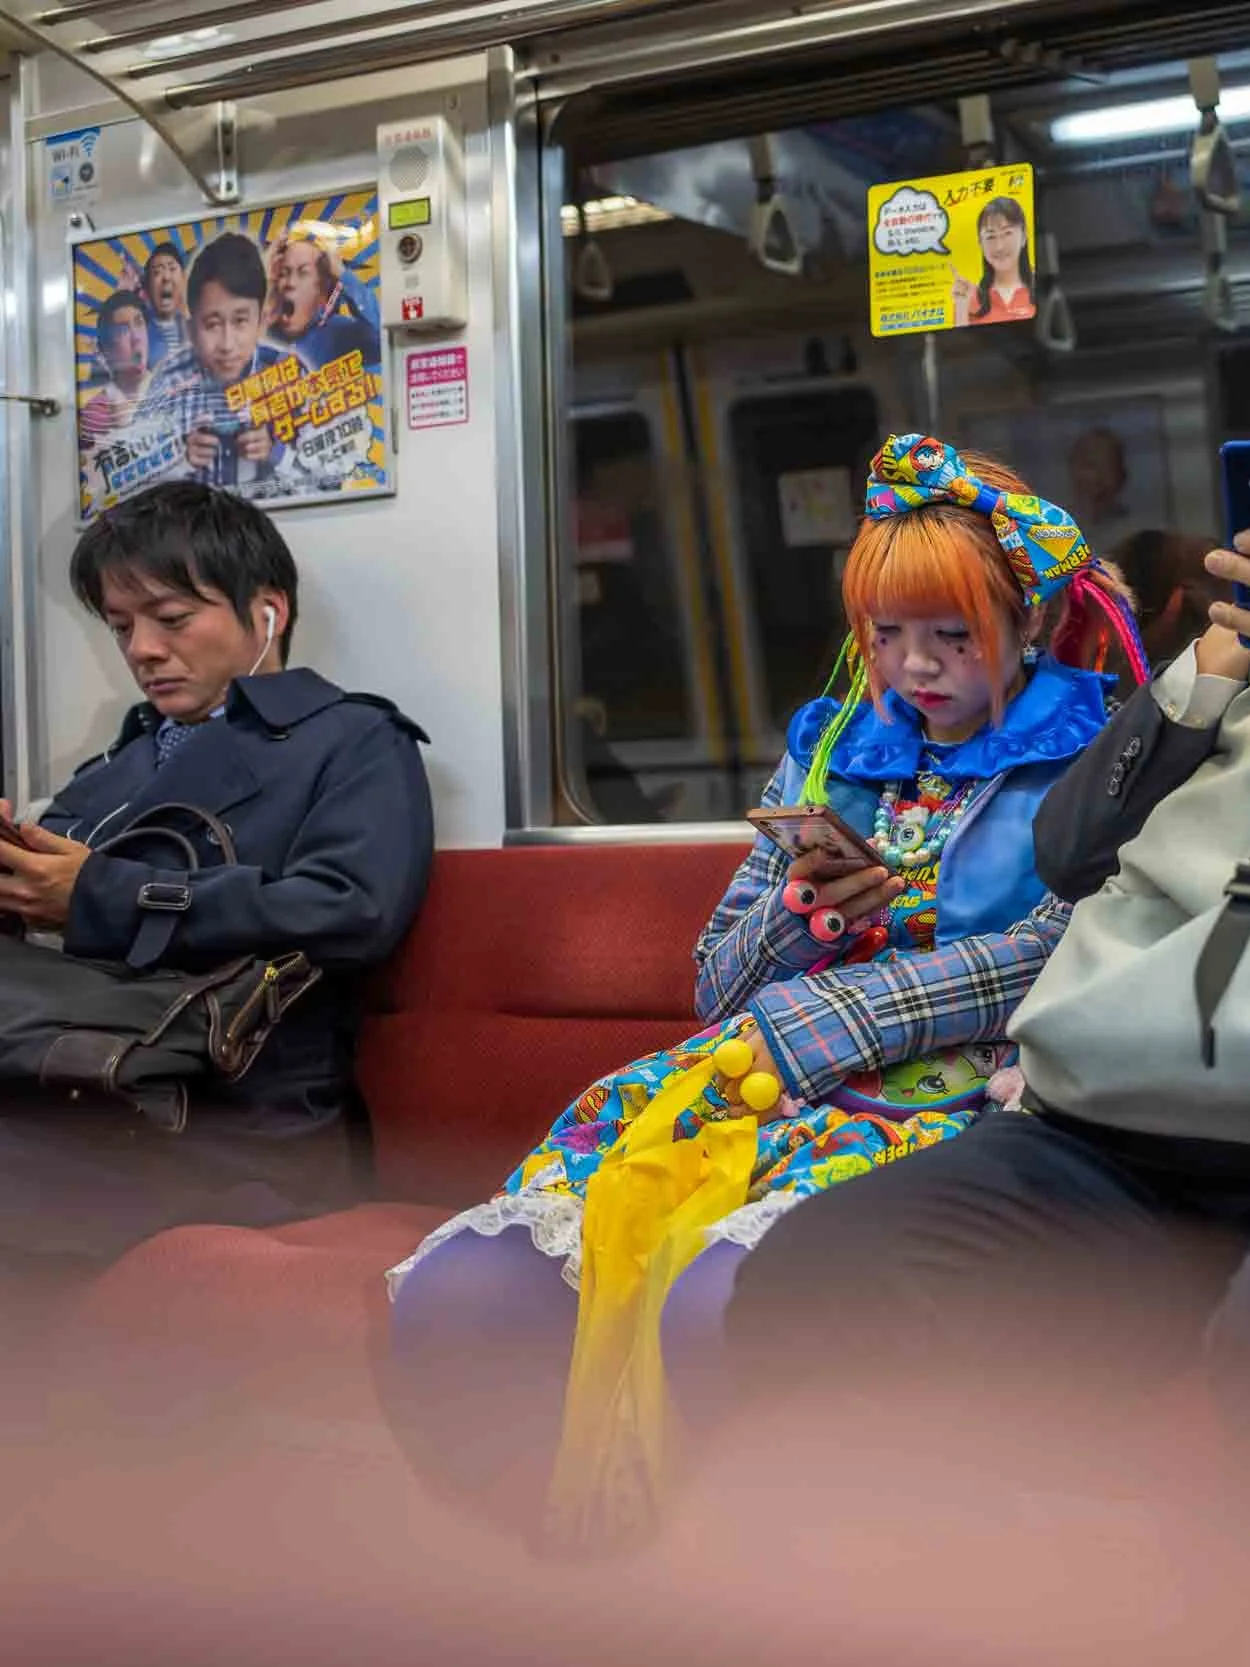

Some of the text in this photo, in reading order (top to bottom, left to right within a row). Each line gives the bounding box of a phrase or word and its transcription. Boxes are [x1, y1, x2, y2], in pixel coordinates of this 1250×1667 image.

[52, 146, 80, 162] Wi-Fi
[224, 353, 300, 413] 日曜夜は
[882, 433, 910, 482] SUPE
